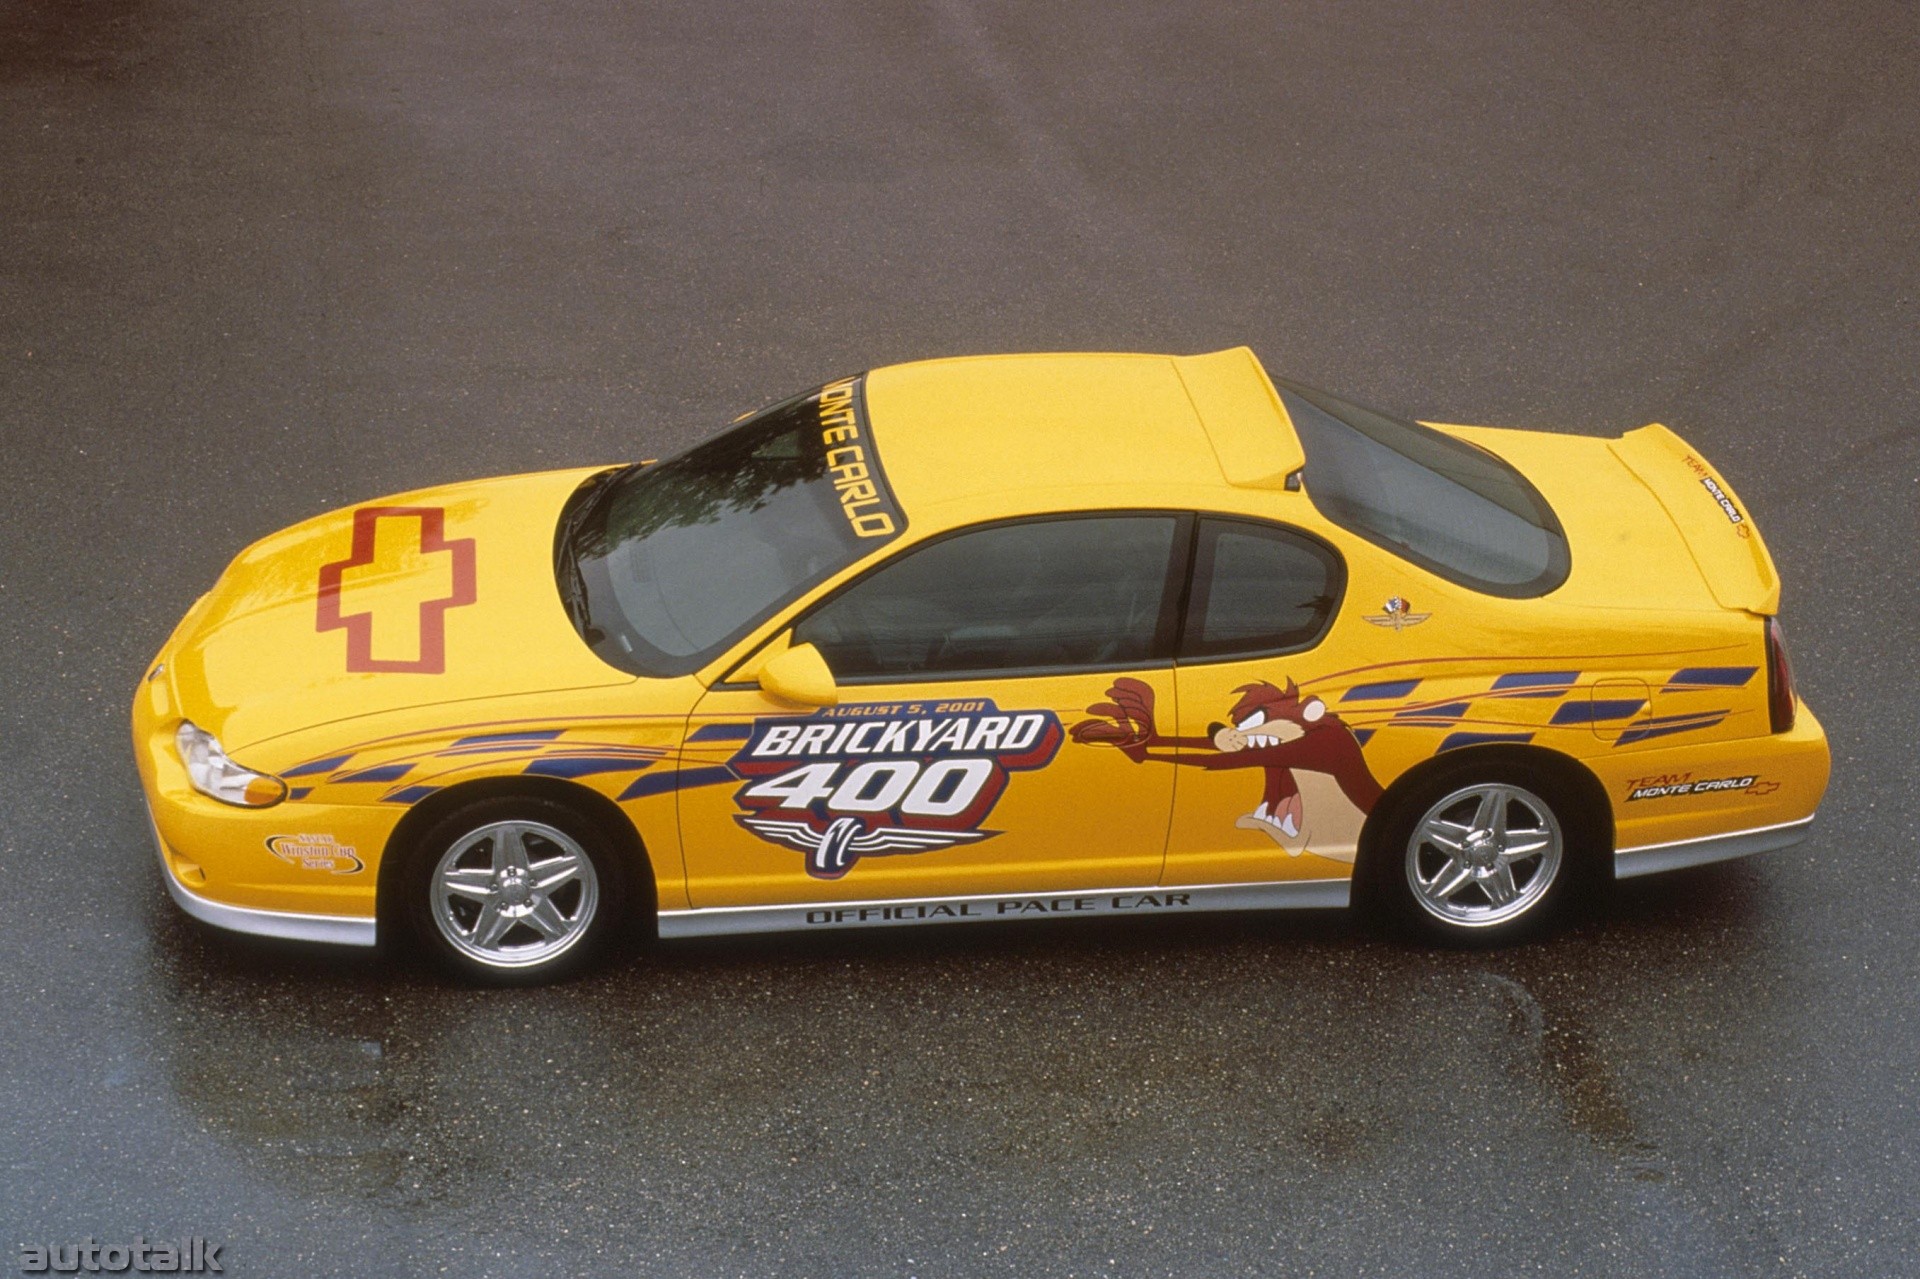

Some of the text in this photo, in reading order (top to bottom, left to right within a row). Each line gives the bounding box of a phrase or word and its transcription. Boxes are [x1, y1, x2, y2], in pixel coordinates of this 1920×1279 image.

[826, 445, 896, 538] CARLO
[1720, 499, 1741, 522] CARLO
[821, 701, 986, 718] AUGUST 5, 2001
[751, 713, 1046, 757] BRICKYARD
[744, 758, 996, 817] 400
[1627, 772, 1692, 790] TEAM
[1633, 777, 1753, 799] MONTE CARLO
[281, 843, 329, 857] Winston
[302, 858, 334, 868] Series
[805, 893, 1192, 924] OFFICIAL PACE CAR
